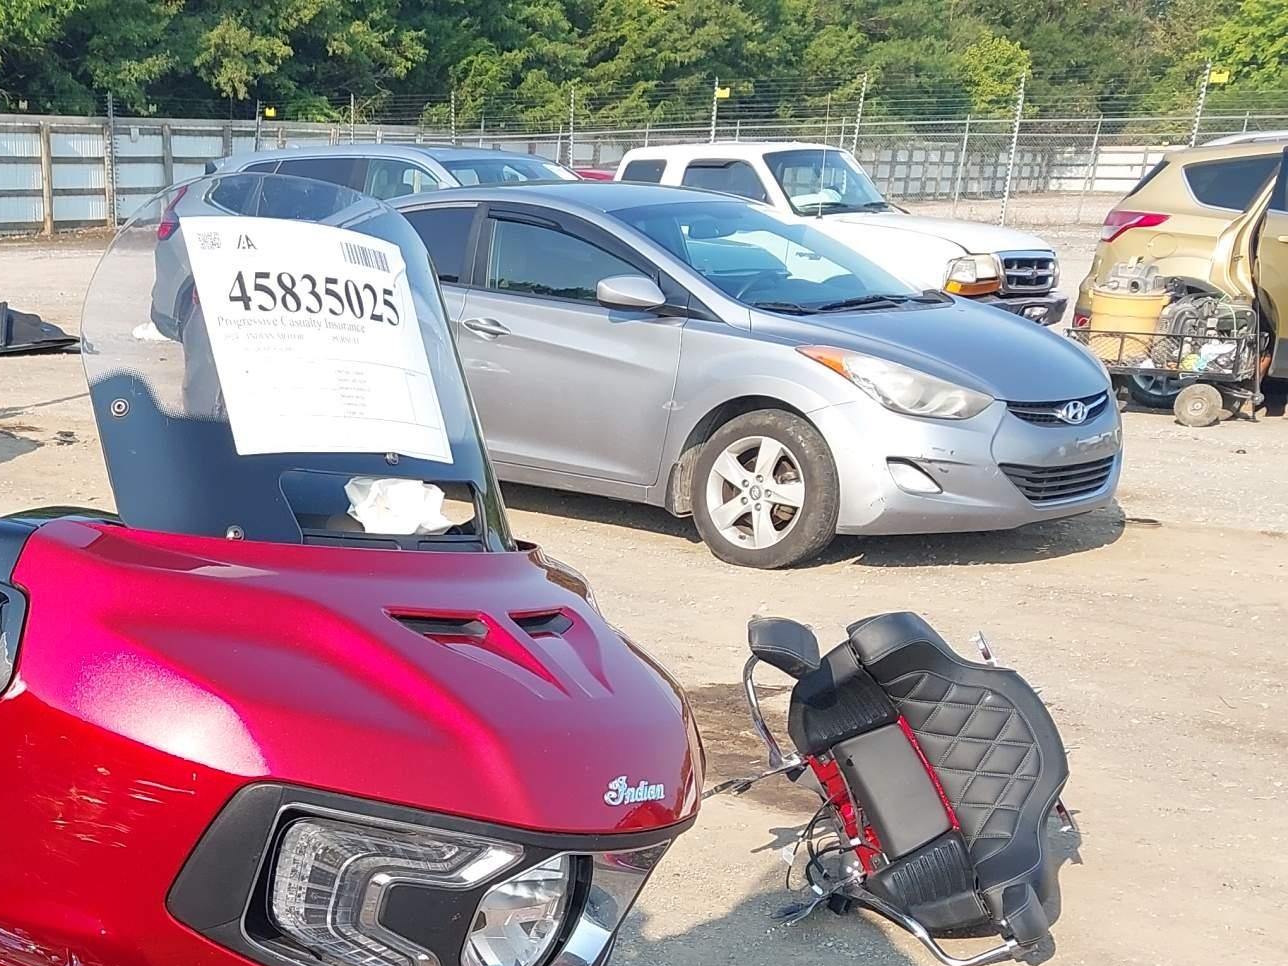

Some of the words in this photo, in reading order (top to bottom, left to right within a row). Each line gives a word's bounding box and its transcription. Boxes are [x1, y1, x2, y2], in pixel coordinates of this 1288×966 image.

[228, 270, 400, 327] 45835025
[217, 315, 278, 330] Progressive
[280, 316, 322, 331] Casualty
[324, 318, 366, 334] Insurance
[604, 775, 665, 806] Indian
